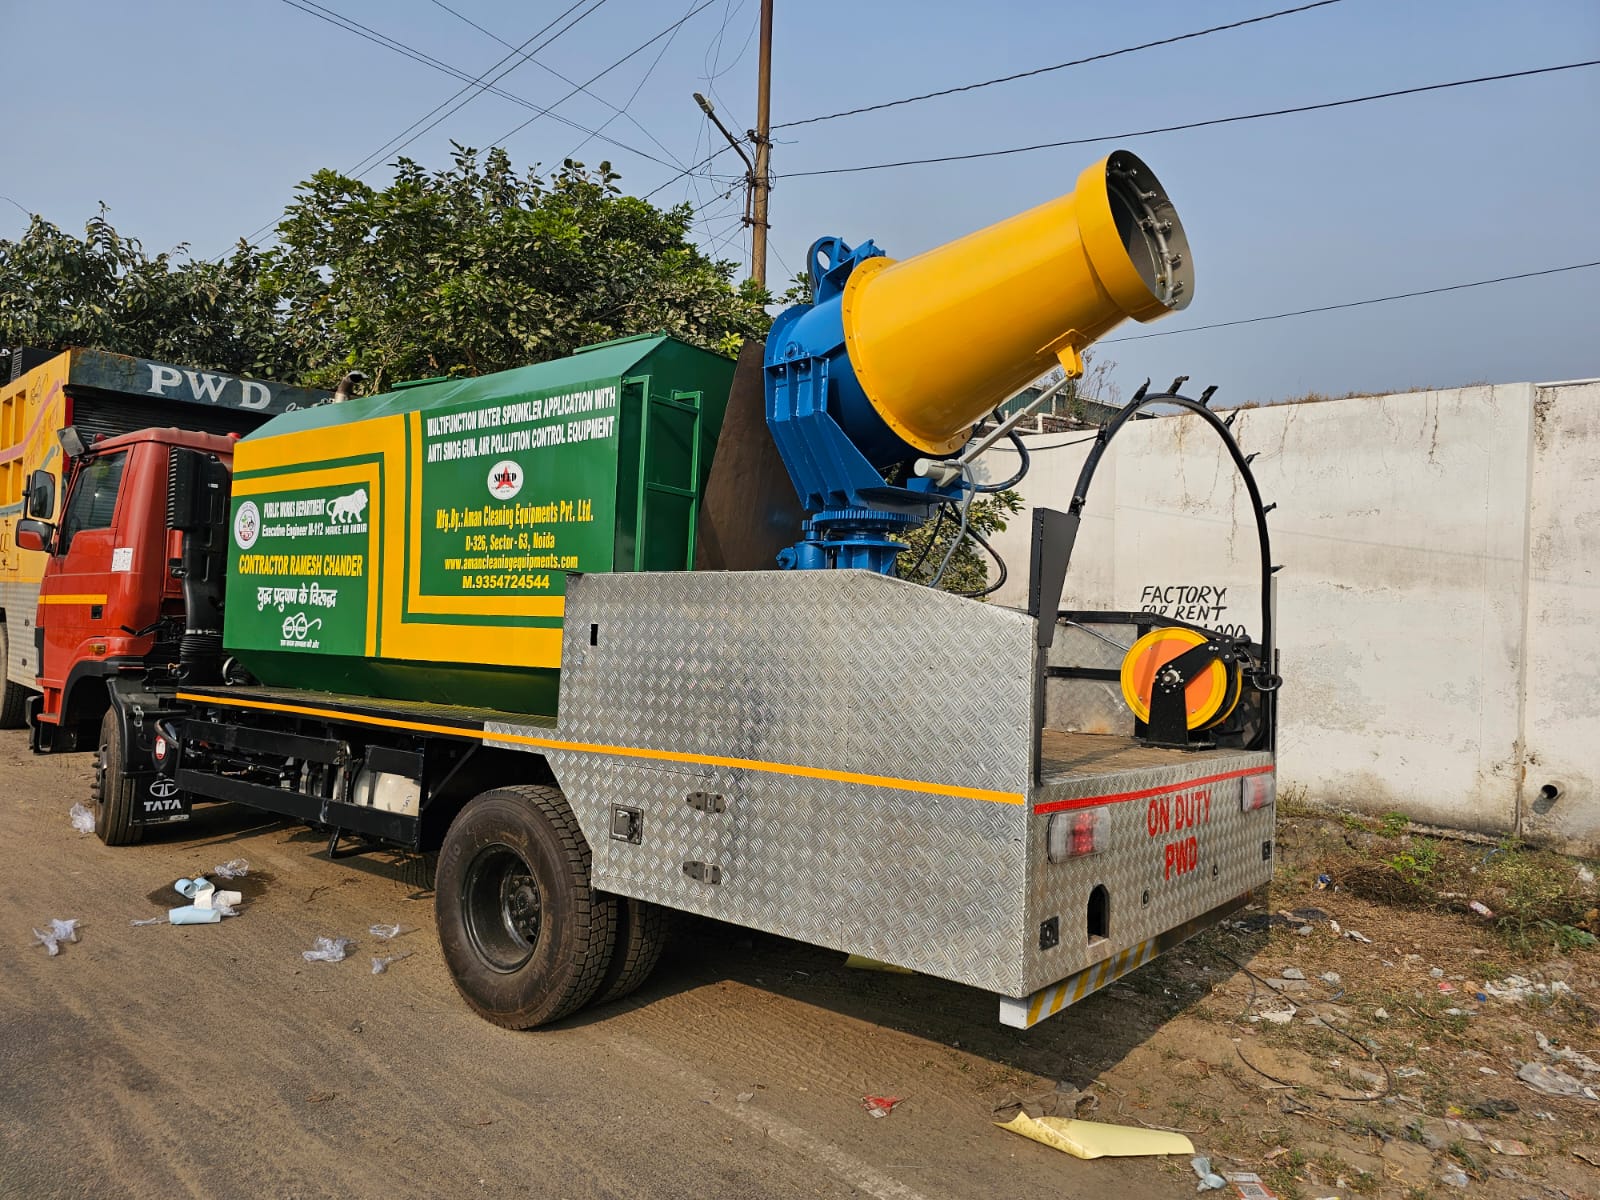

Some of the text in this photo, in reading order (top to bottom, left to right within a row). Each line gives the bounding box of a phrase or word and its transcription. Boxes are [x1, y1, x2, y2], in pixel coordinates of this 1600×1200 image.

[147, 363, 271, 410] PWD
[427, 386, 616, 437] MULTIFUNCTION WATER SPRINKLER APPLICATION WITH
[427, 443, 442, 463] ANTI
[443, 440, 461, 461] SMOG
[478, 436, 490, 456] AIR
[490, 430, 531, 454] POLLUTION
[531, 424, 566, 449] CONTROL
[567, 416, 615, 443] EQUIPMENT
[263, 502, 280, 519] PUBLIC
[279, 501, 296, 518] WORKS
[295, 498, 326, 517] DEPARTMENT
[483, 504, 514, 530] Cleaning
[515, 501, 558, 529] Equipments
[559, 500, 575, 522] Pvt.
[577, 499, 594, 522] Ltd.
[262, 524, 286, 537] Executive
[286, 523, 308, 540] Engineer
[325, 523, 368, 535] MAKE IN INDIA
[533, 531, 555, 549] Noida
[239, 554, 363, 577] CONTRACTOR RAMESH CHANDER
[444, 553, 578, 572] www.amancleaningequipments.com
[462, 574, 550, 589] M.9354724544
[257, 586, 273, 612] युद्ध
[298, 582, 309, 605] के
[1140, 585, 1228, 606] FACTORY
[1174, 605, 1228, 621] RENT
[144, 799, 182, 812] TATA
[1147, 789, 1212, 837] ON DUTY
[1165, 836, 1198, 881] PWD
